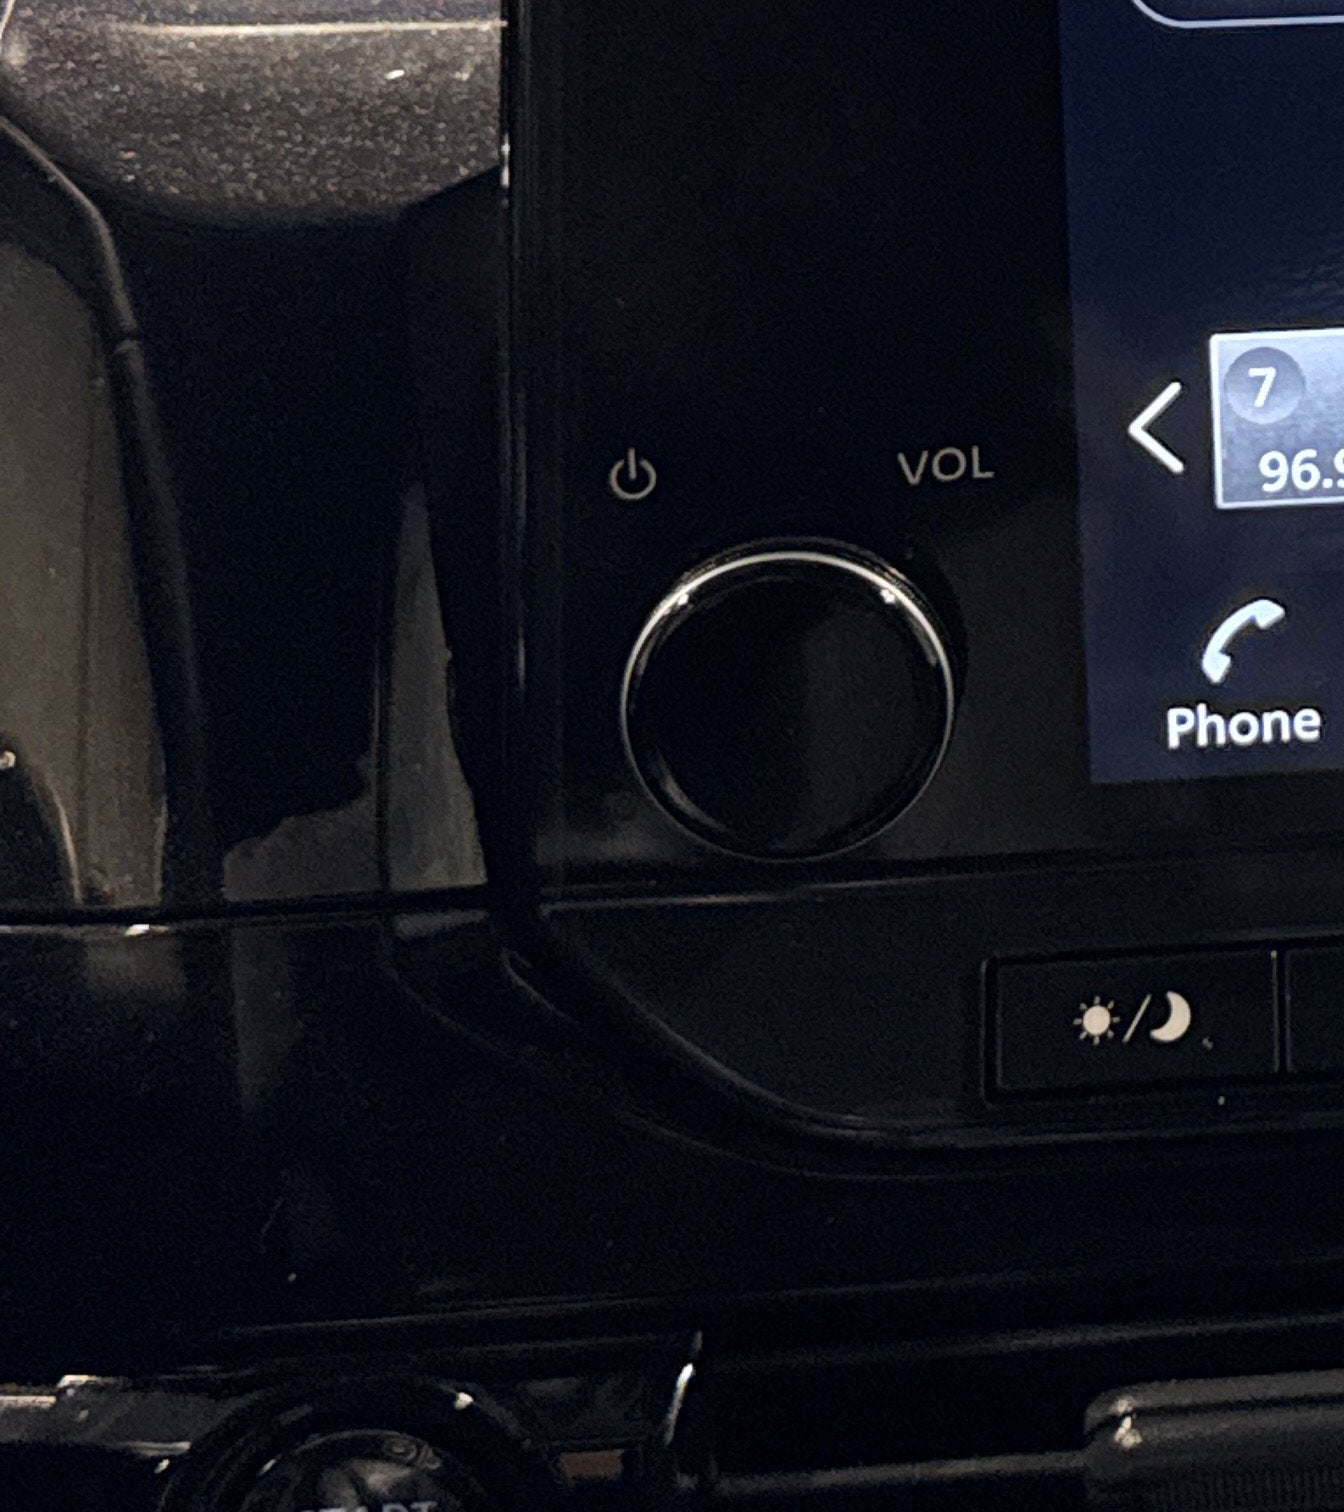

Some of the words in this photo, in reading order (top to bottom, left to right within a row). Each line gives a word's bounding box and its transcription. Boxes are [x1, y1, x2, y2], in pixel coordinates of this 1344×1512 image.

[1246, 366, 1276, 408] 7
[897, 445, 994, 485] VOL
[1167, 703, 1321, 749] Phone
